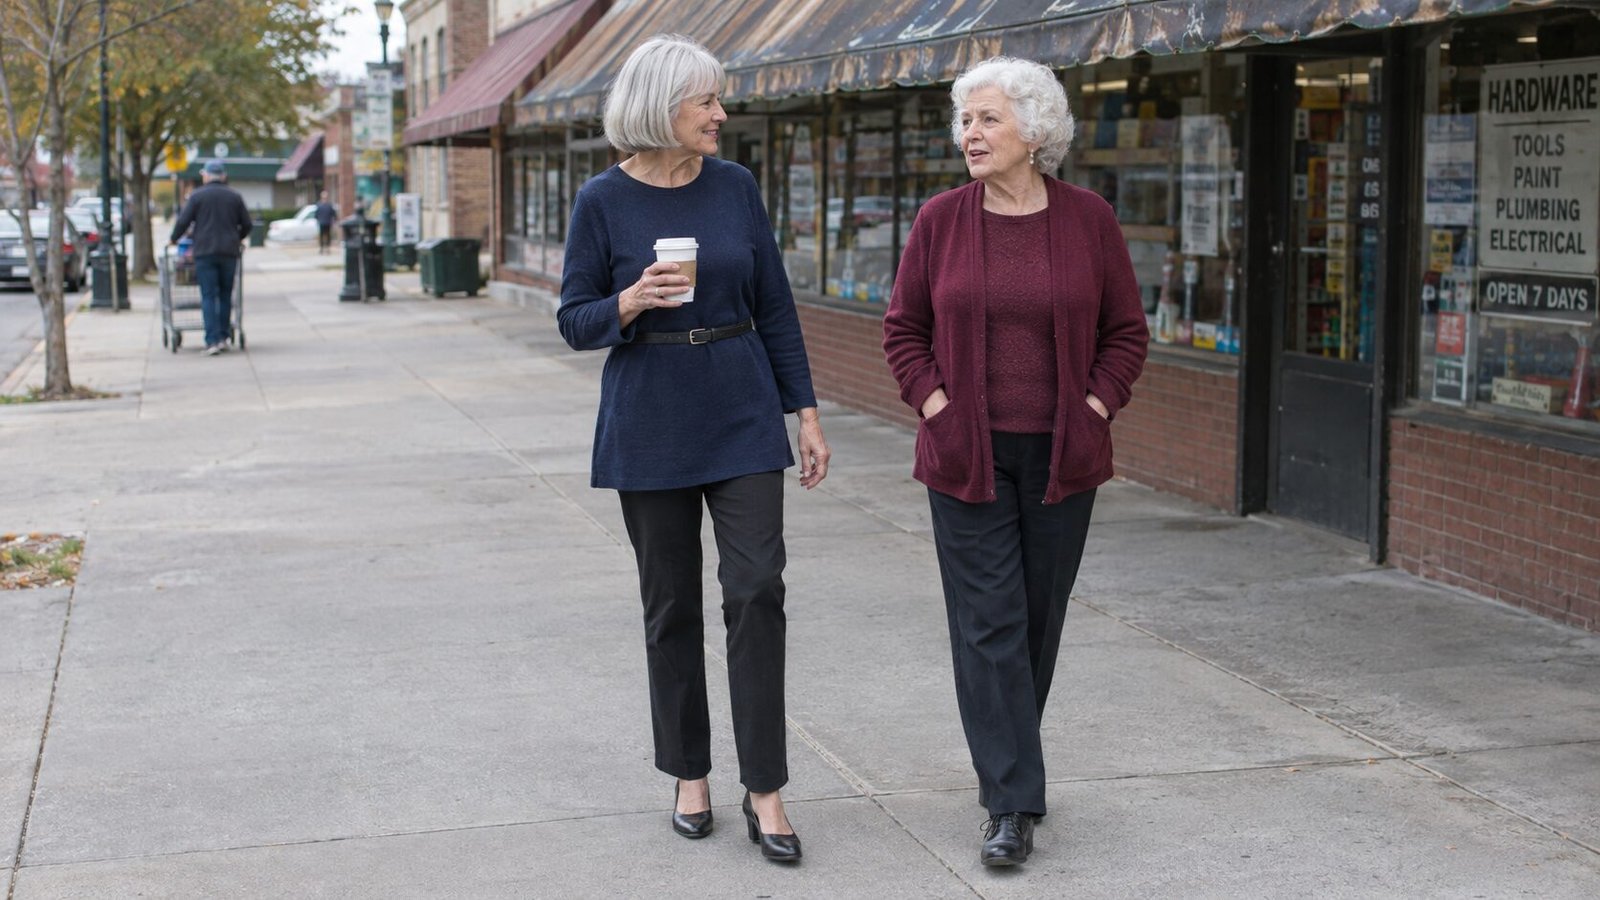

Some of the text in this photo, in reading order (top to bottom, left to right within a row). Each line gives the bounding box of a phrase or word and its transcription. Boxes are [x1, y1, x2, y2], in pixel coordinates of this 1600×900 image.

[1488, 73, 1598, 114] HARDWARE
[1513, 133, 1565, 156] TOOLS
[1514, 166, 1562, 188] PAINT
[1496, 198, 1580, 221] PLUMBING
[1490, 229, 1586, 254] ELECTRICAL
[1487, 281, 1588, 310] OPEN 7 DAYS
